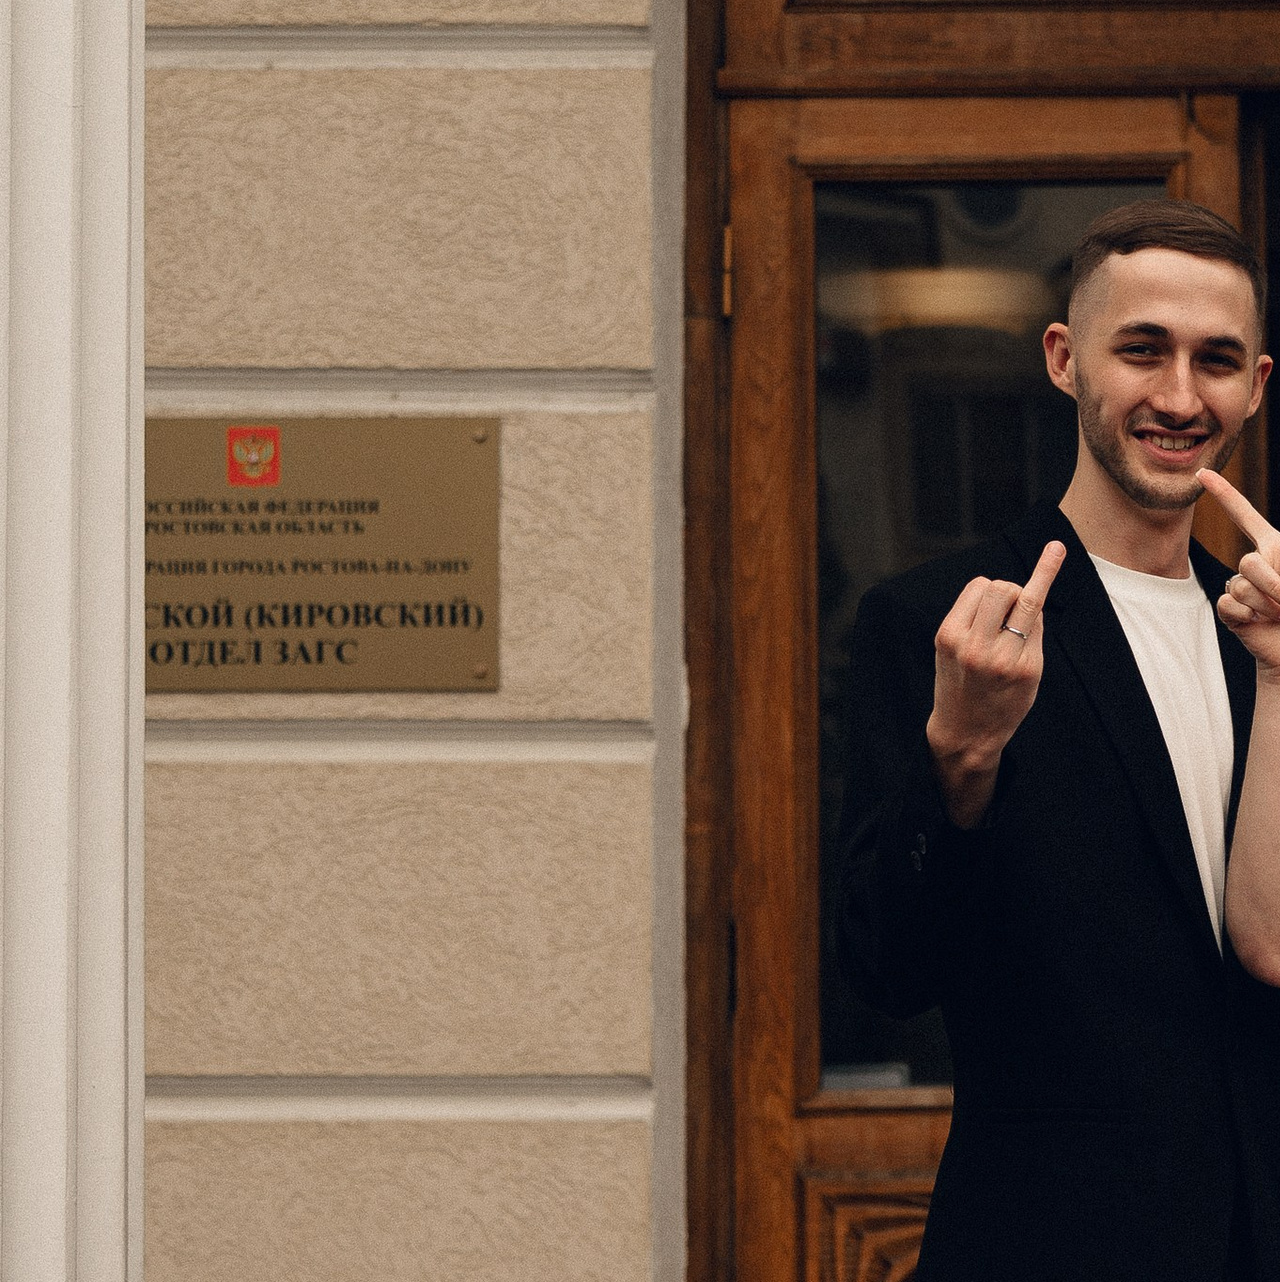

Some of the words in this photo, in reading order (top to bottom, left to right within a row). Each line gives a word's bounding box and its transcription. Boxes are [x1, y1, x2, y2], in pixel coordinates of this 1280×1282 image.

[264, 499, 380, 516] ФЕДЕРАЦИЯ
[275, 519, 365, 535] ОБЛАСТЬ
[211, 560, 287, 576] ГОРОДА
[290, 559, 472, 575] РОСТОВА-НА-ДОНУ
[244, 597, 484, 630] (КИРОВСКИЙ)
[148, 639, 262, 667] ОТДЕЛ
[273, 639, 359, 666] ЗАГС
